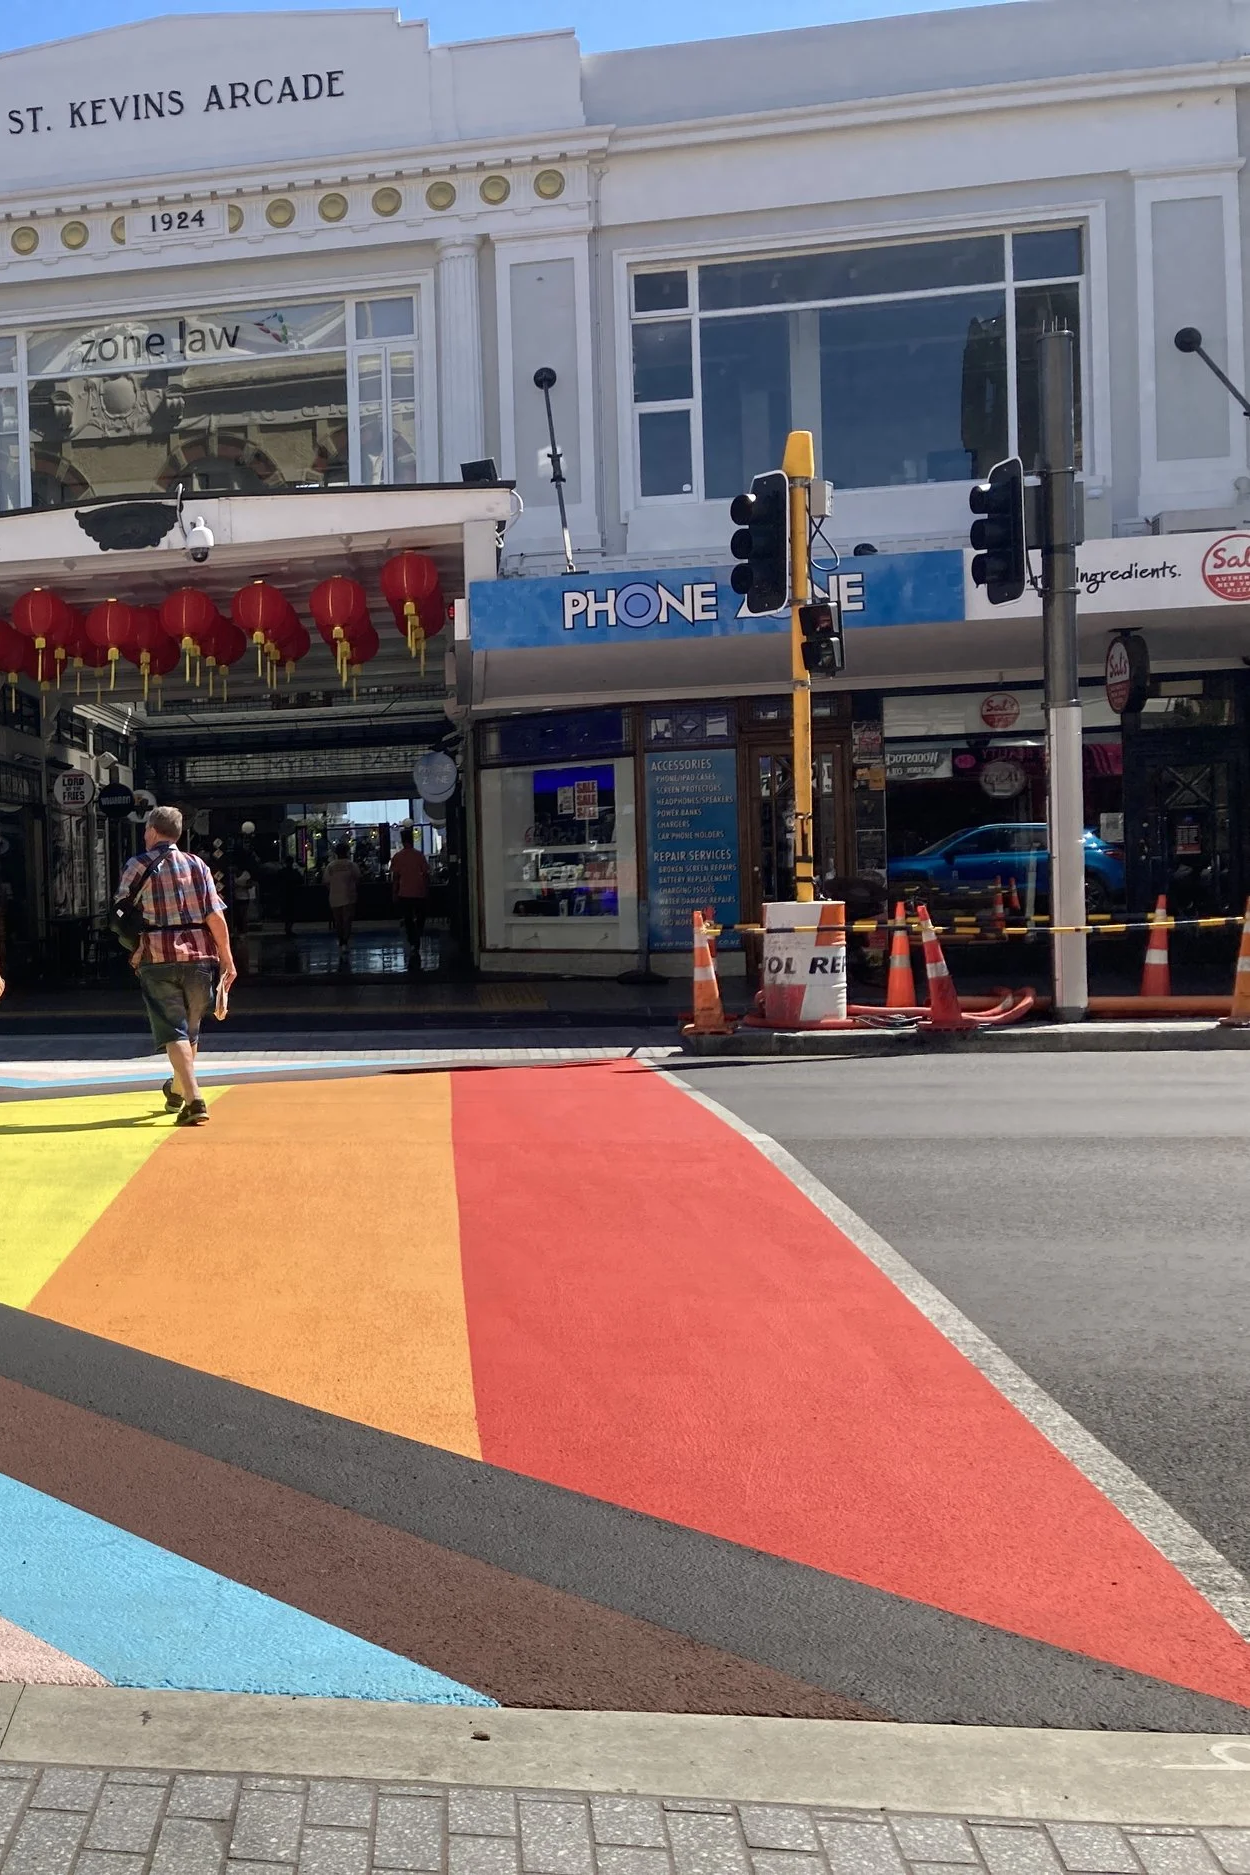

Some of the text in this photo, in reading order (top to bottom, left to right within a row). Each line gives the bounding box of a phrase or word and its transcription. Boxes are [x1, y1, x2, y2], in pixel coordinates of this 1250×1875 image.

[8, 70, 346, 135] ST. KEVINS ARCADE
[150, 209, 205, 232] 1924
[81, 320, 240, 364] zone law
[1076, 561, 1182, 593] Ingredients.
[562, 572, 865, 630] PHONE NE
[418, 764, 451, 774] PHNE
[651, 759, 712, 771] ACCESSORIES
[62, 778, 85, 787] LORD
[422, 775, 449, 785] ZNE
[576, 782, 597, 794] SALE
[656, 784, 722, 794] SCREEN PROTECTORS
[62, 791, 85, 801] FRIES
[576, 794, 597, 806] SALE
[656, 808, 702, 817] POWER BANKS
[657, 821, 690, 829] CHARGERS
[654, 849, 732, 862] REPAIR SERVICES
[686, 864, 709, 873] SCREEN
[710, 863, 737, 872] REPAIRS
[658, 874, 732, 884] BATTERY REPLACEMENT
[710, 895, 736, 903] REPAIRS
[765, 956, 797, 974] OL
